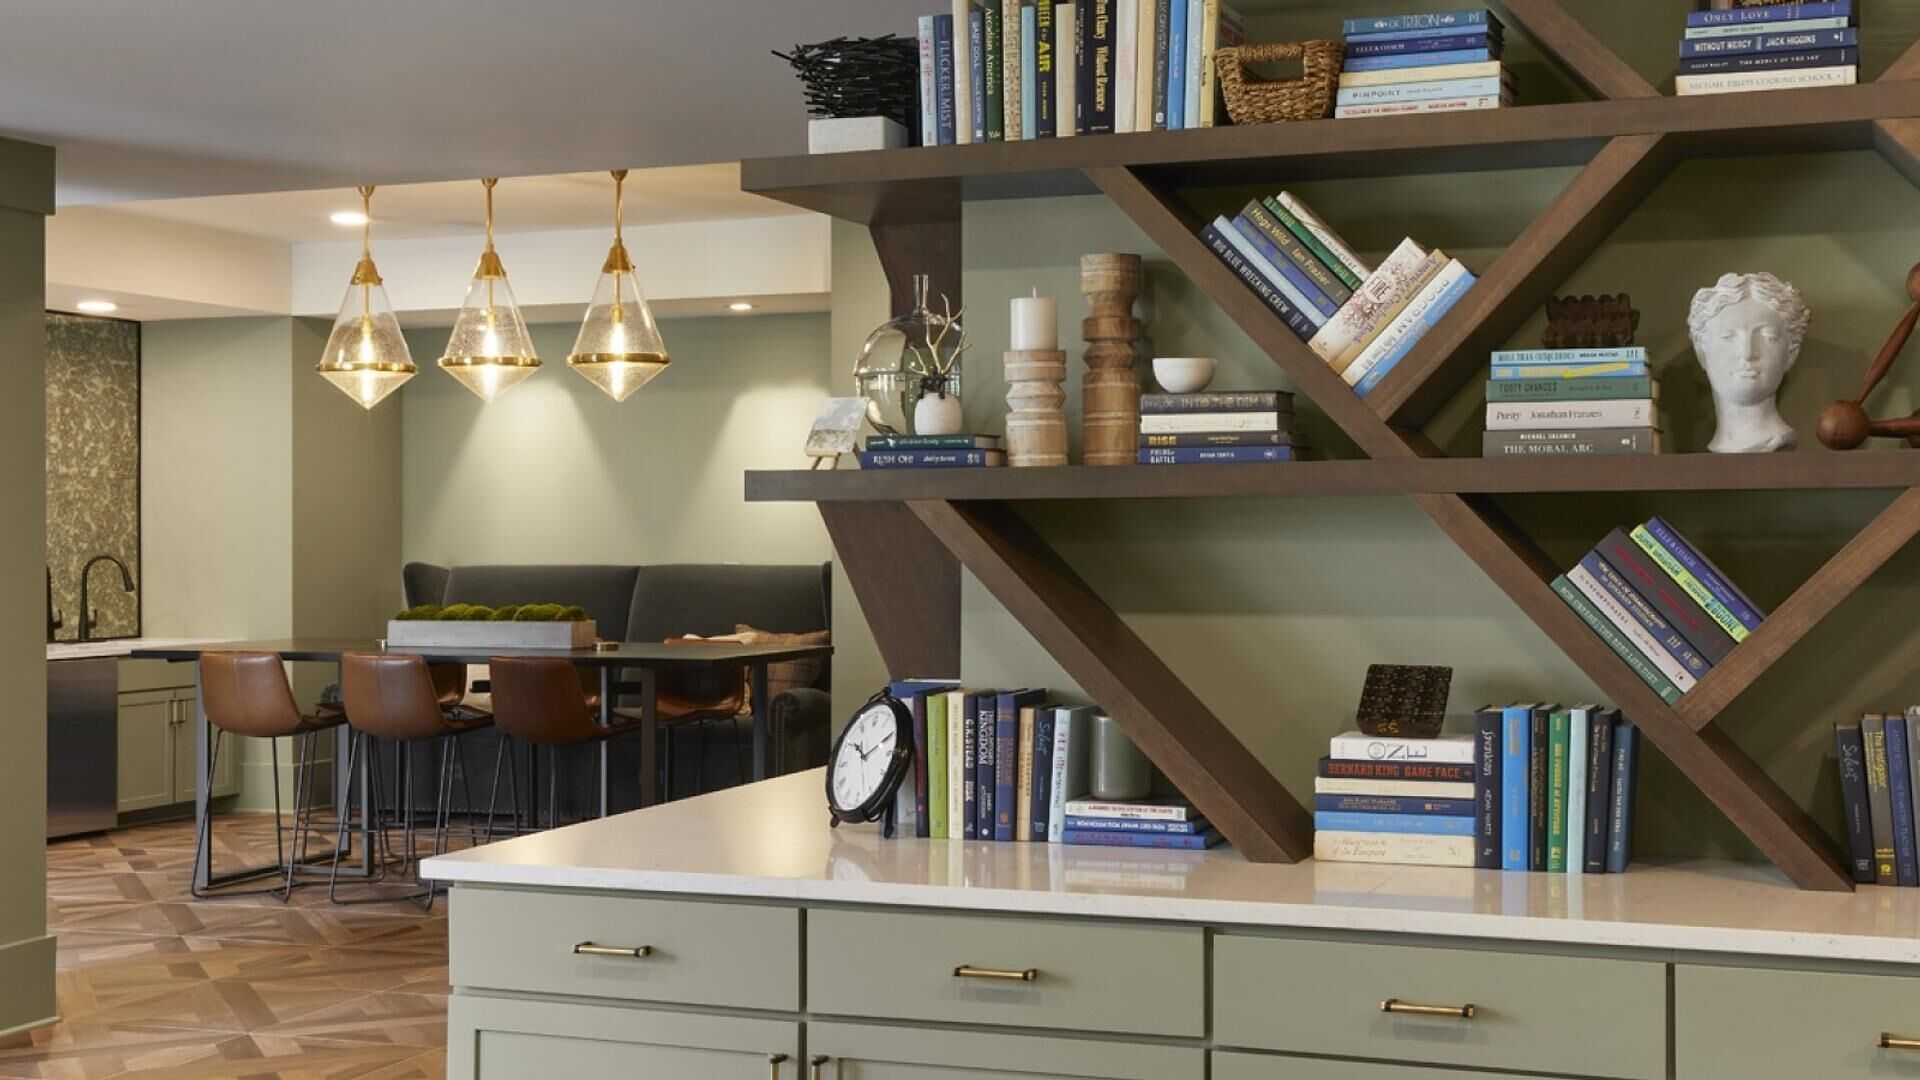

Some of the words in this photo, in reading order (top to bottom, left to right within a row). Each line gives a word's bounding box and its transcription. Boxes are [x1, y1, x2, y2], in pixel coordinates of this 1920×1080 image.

[1704, 12, 1734, 22] ONLY
[1741, 10, 1770, 20] LOVE
[985, 8, 994, 50] Arcadian
[1695, 42, 1726, 52] WITHOUT
[1766, 38, 1785, 47] JACK
[1787, 35, 1816, 45] HIGGINS
[1039, 41, 1050, 72] AIR
[939, 40, 950, 92] FLICKER
[986, 54, 995, 96] America
[1353, 90, 1401, 99] PINPOINT
[1239, 263, 1271, 298] WRECKING
[1524, 382, 1557, 392] CHANCES
[1496, 411, 1522, 422] Purity
[1529, 409, 1567, 419] Jonathan
[1569, 408, 1602, 418] Franzen
[1148, 436, 1177, 445] RISE
[1503, 445, 1524, 454] THE
[1529, 444, 1568, 454] MORAL
[1570, 443, 1594, 453] ARC
[979, 710, 988, 765] KINGDOM
[1874, 731, 1884, 746] The
[1328, 763, 1373, 775] BERNARD
[1375, 764, 1399, 776] KING
[1404, 766, 1433, 778] GAME
[1435, 766, 1461, 778] FACE
